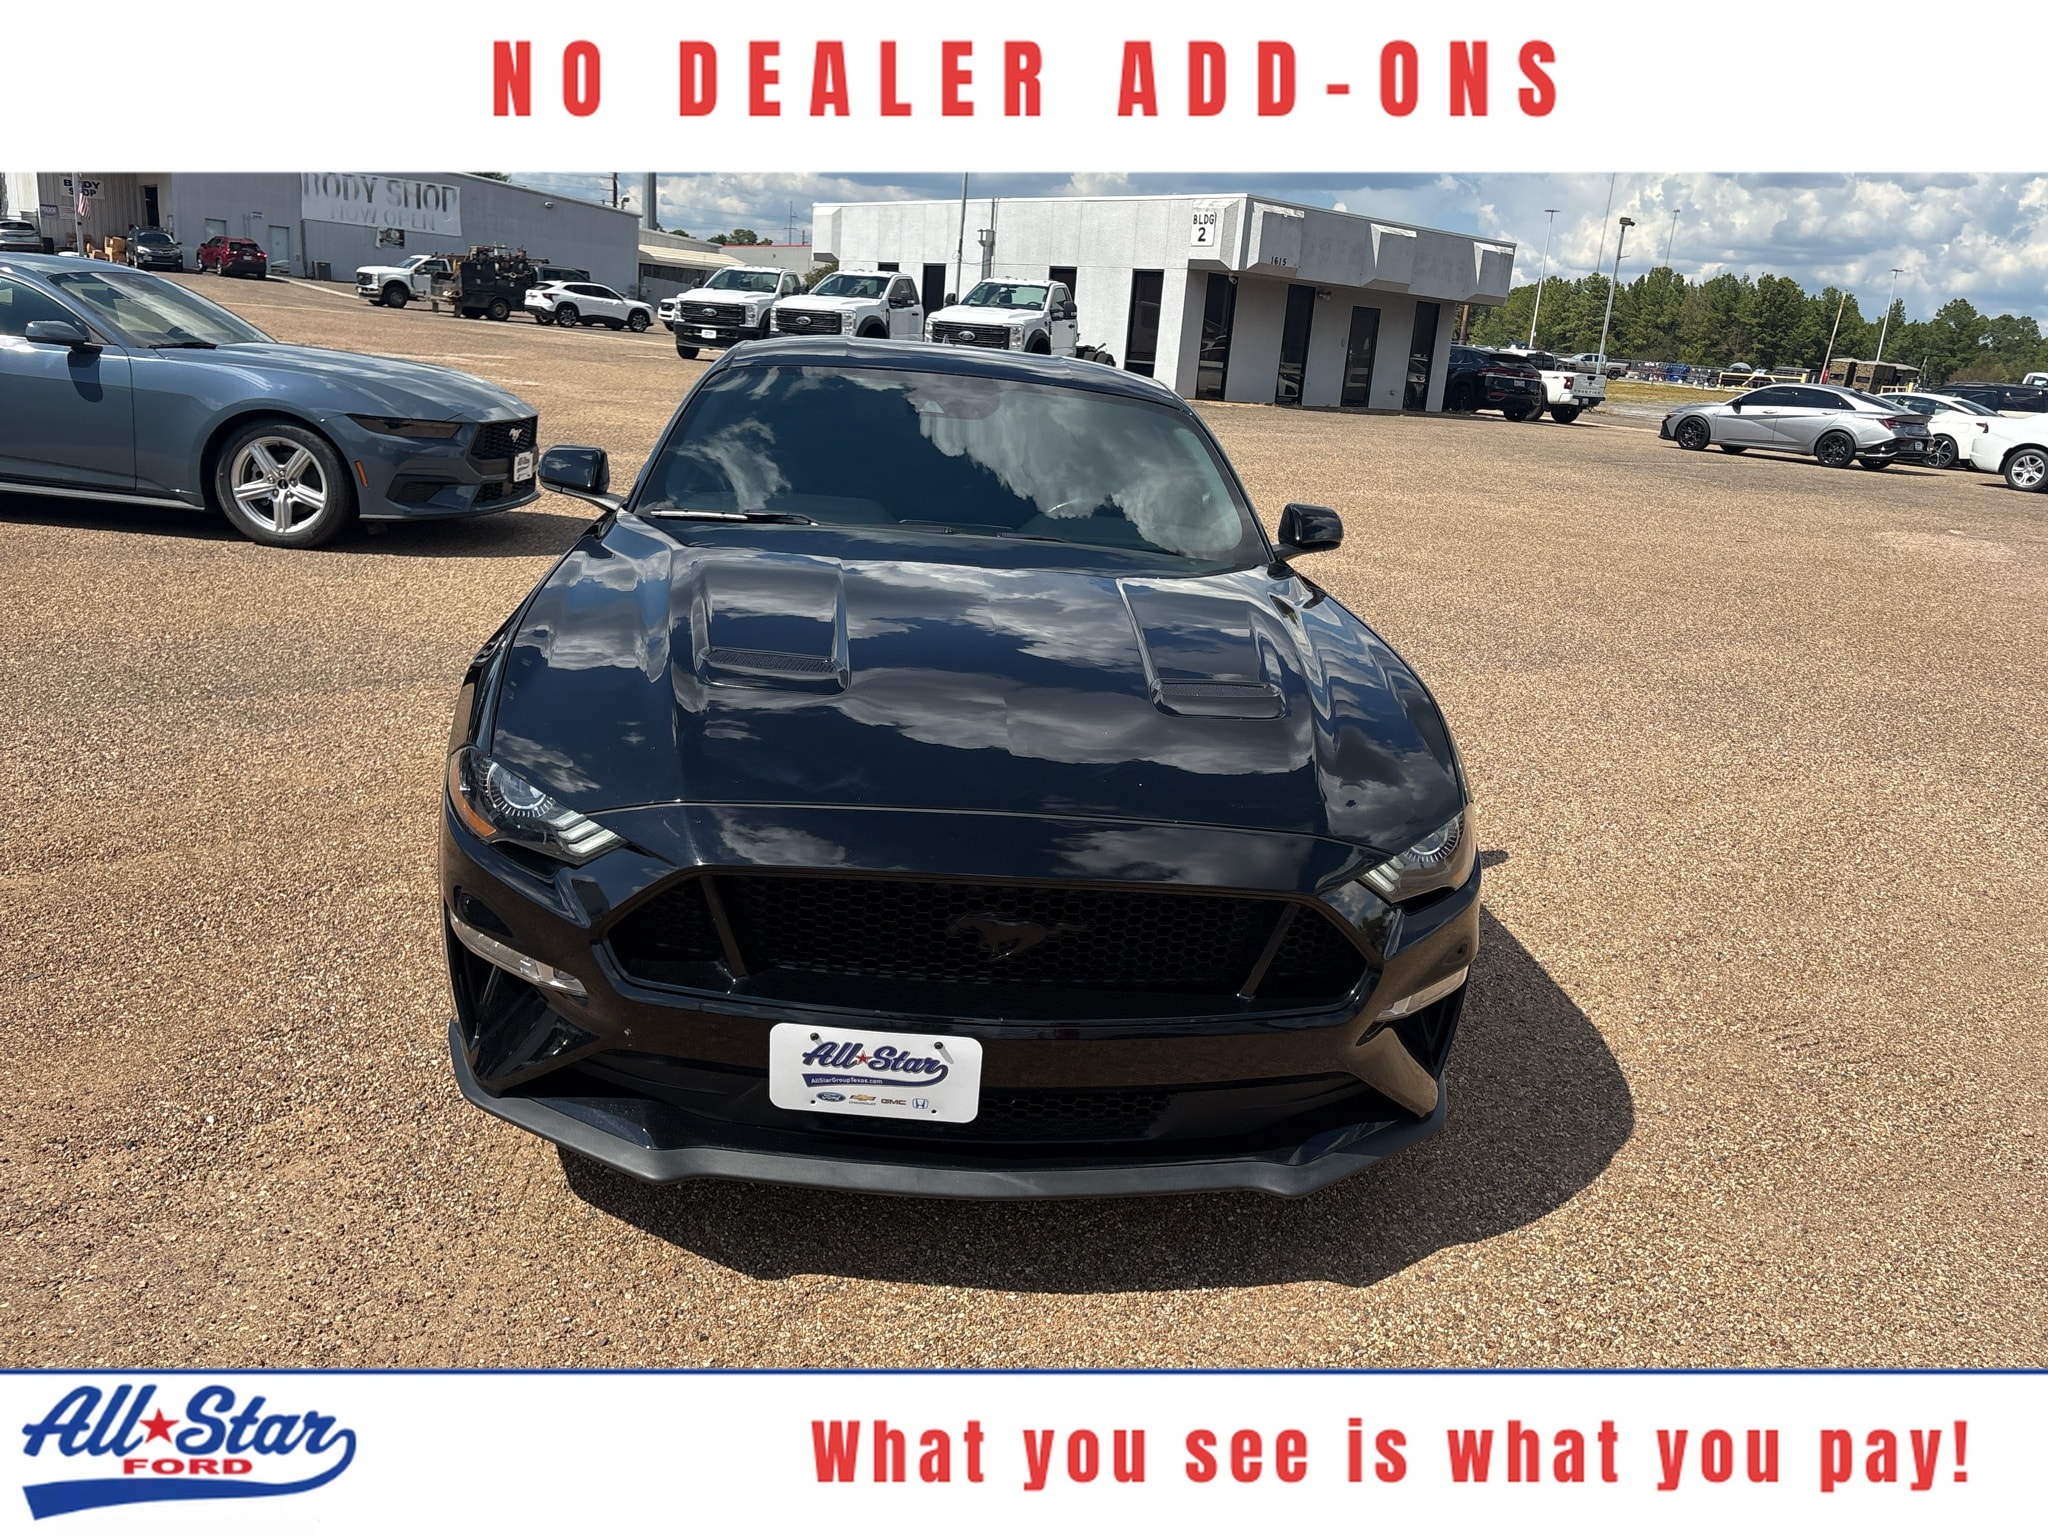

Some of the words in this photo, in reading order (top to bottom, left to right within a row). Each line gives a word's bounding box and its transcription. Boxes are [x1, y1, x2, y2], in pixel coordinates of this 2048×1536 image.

[63, 179, 100, 189] BDY
[69, 187, 96, 197] SOP
[387, 179, 457, 212] SHOP
[383, 208, 436, 231] OPEN
[1193, 214, 1215, 225] BLDG
[1197, 227, 1206, 242] 2
[1270, 256, 1287, 266] 1615
[802, 1041, 863, 1069] All
[867, 1045, 948, 1075] Star
[811, 1077, 883, 1085] AllStarGroupTexas.com
[880, 1098, 907, 1106] GMC
